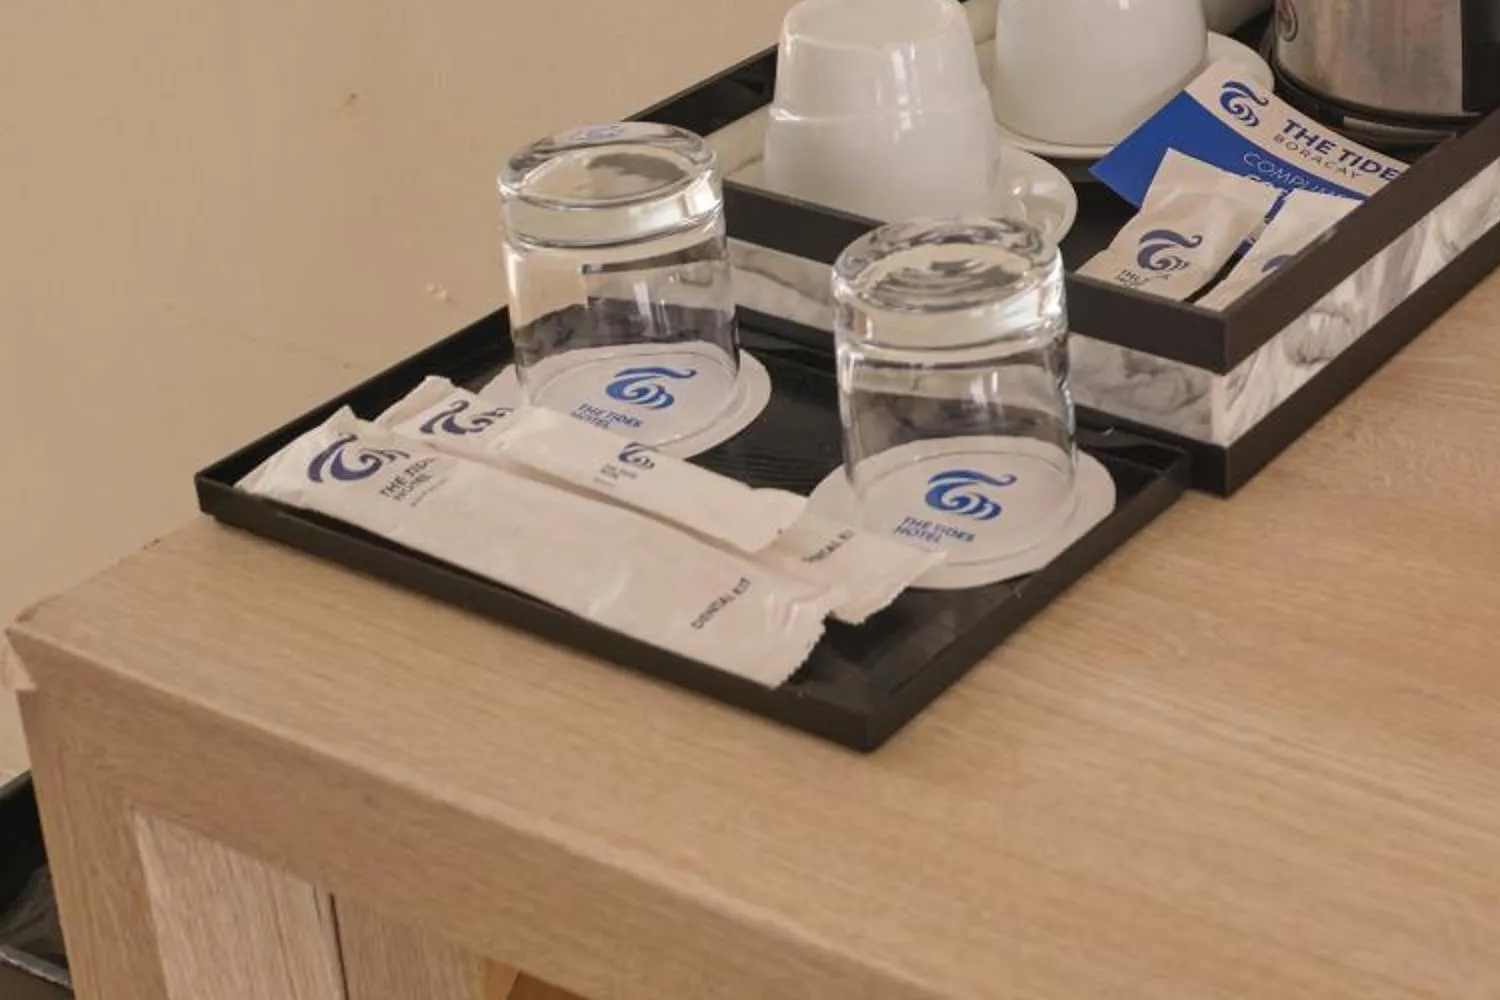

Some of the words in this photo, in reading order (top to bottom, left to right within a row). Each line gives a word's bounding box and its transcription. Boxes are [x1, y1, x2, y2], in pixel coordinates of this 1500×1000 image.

[1273, 133, 1362, 180] BORACAY
[1283, 118, 1336, 155] THE
[1337, 148, 1400, 180] TIDE
[690, 595, 736, 629] DENTAL
[732, 577, 751, 595] KIT
